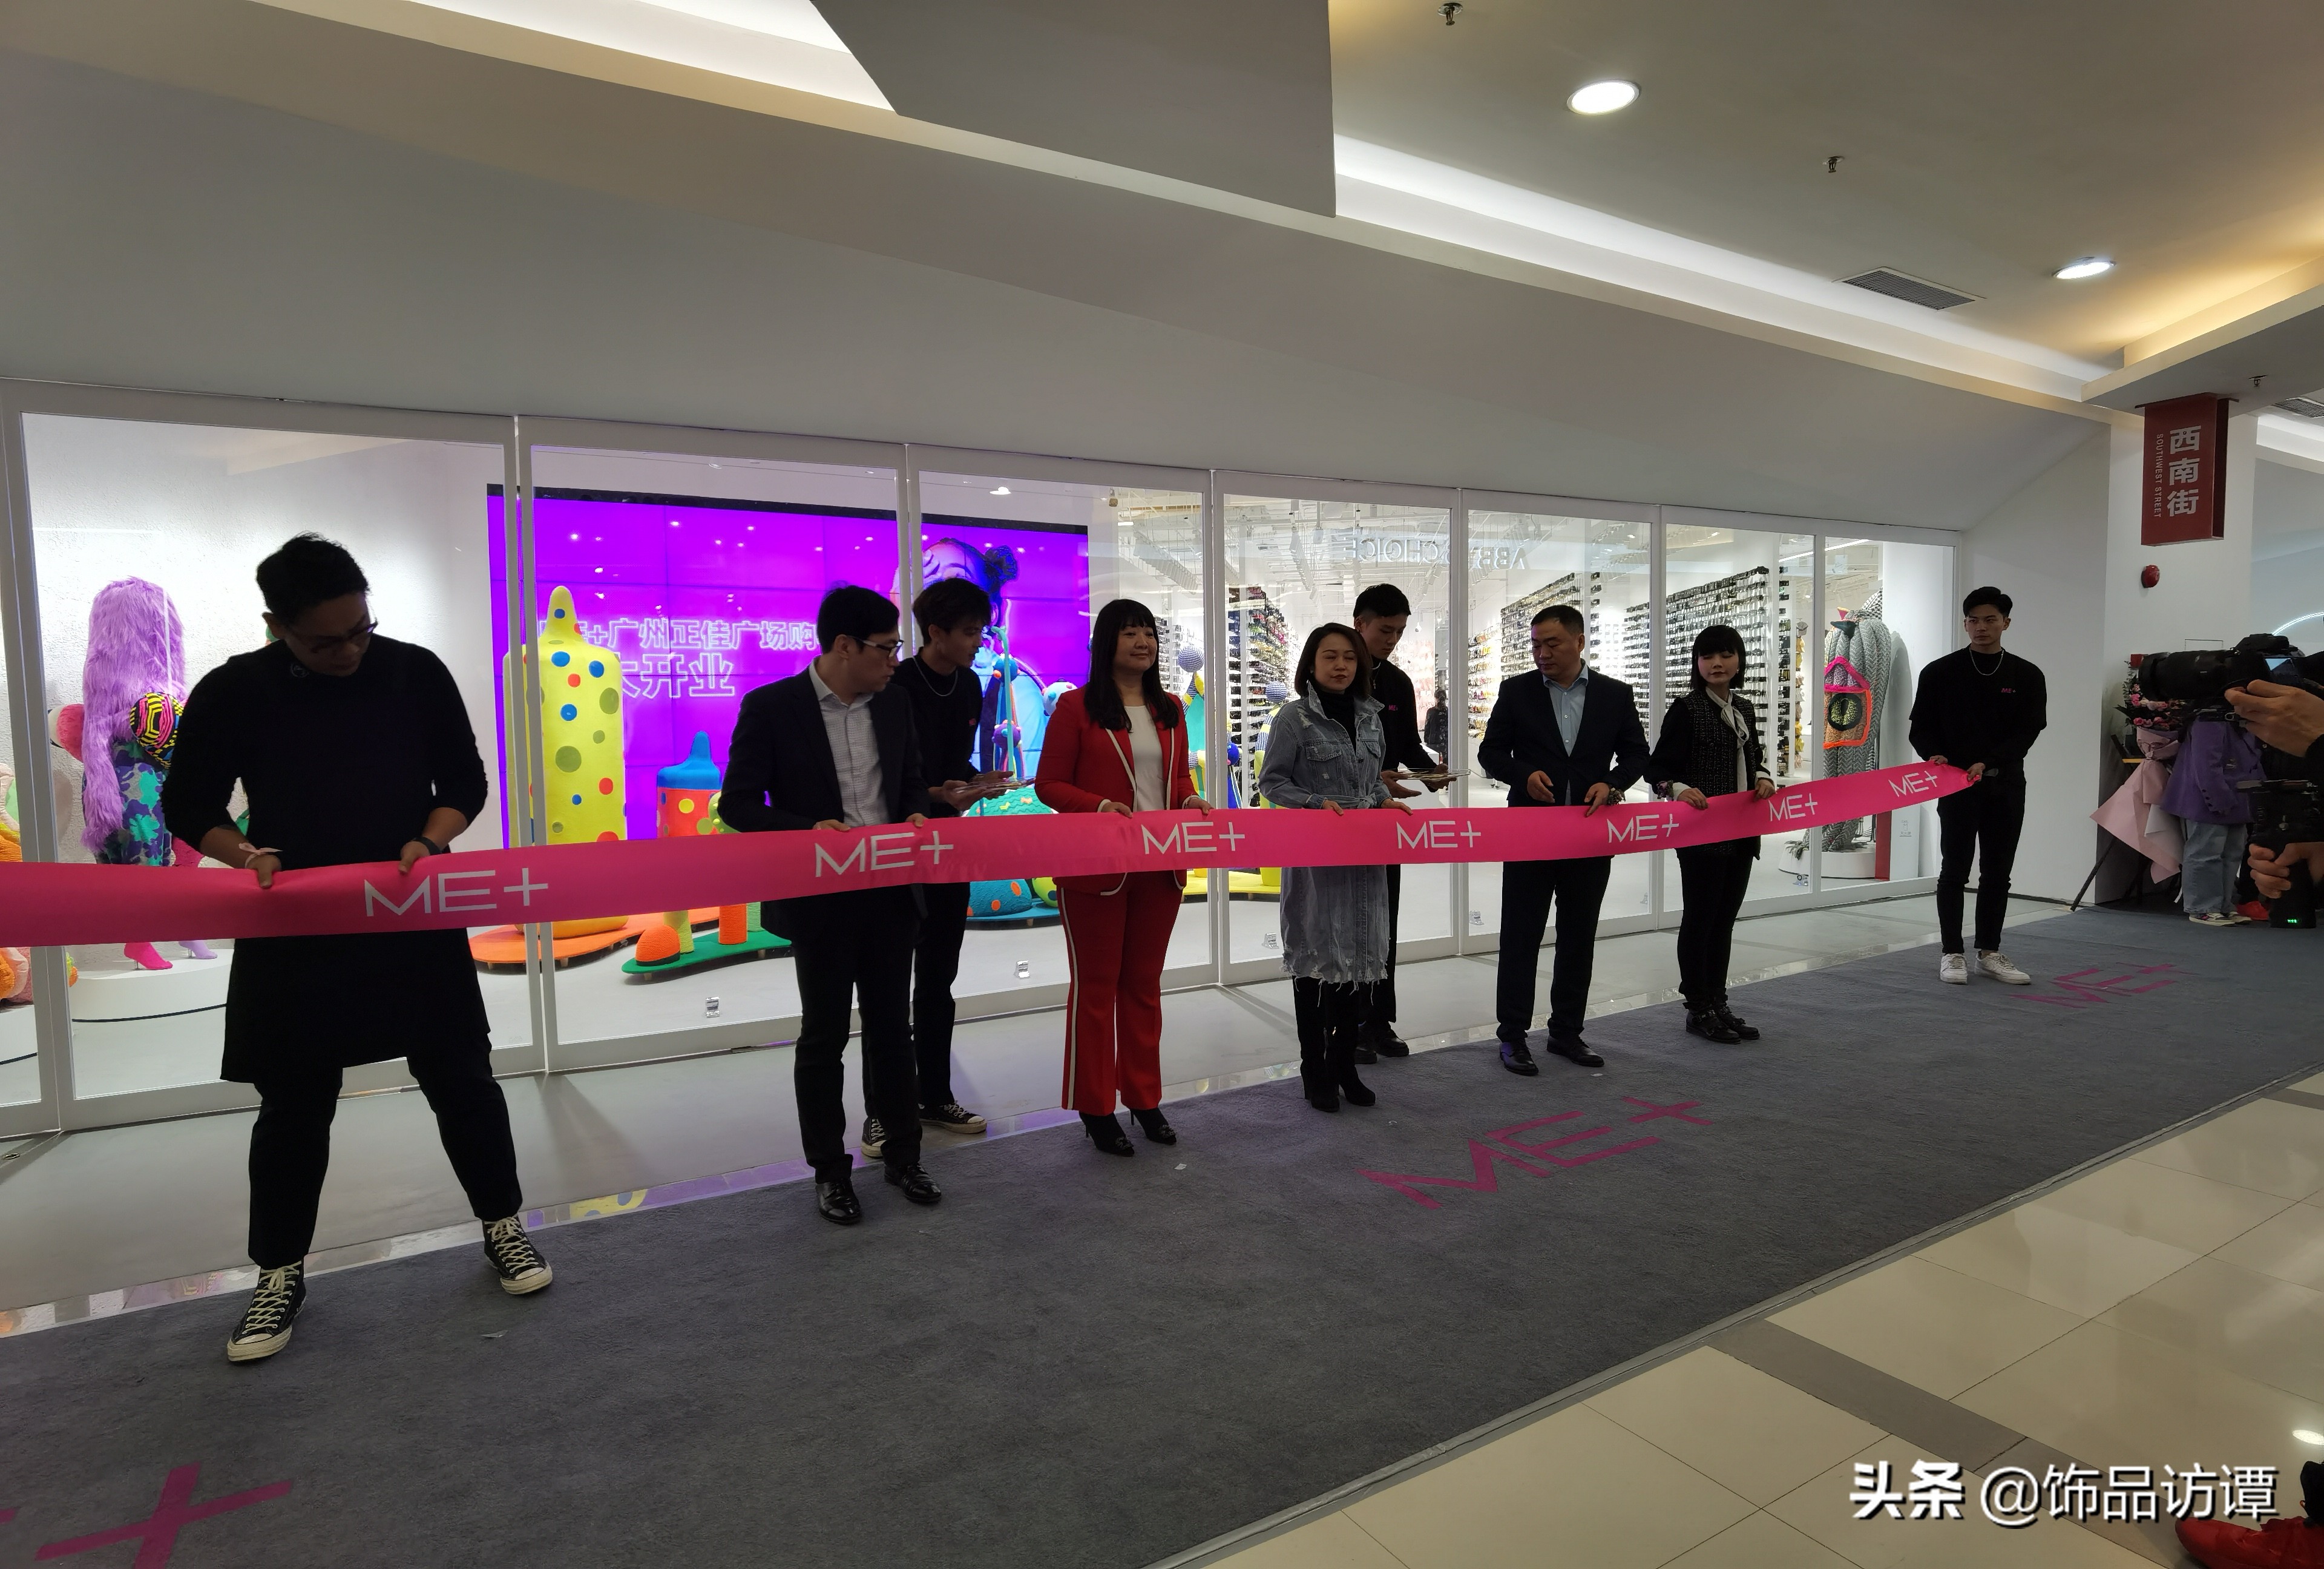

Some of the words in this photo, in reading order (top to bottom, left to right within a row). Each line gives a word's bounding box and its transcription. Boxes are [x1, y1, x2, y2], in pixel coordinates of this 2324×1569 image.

[2155, 434, 2164, 484] SOUTHWEST
[2167, 426, 2201, 516] 西南街
[1768, 792, 1818, 821] ME+
[1888, 770, 1938, 798] ME+
[1141, 821, 1246, 855] ME+
[1396, 820, 1482, 849] ME+
[1607, 814, 1679, 843] ME+
[815, 831, 954, 877] ME+
[364, 867, 548, 917] ME+
[2001, 962, 2201, 1010] ME+
[1355, 1096, 1715, 1210] ME+
